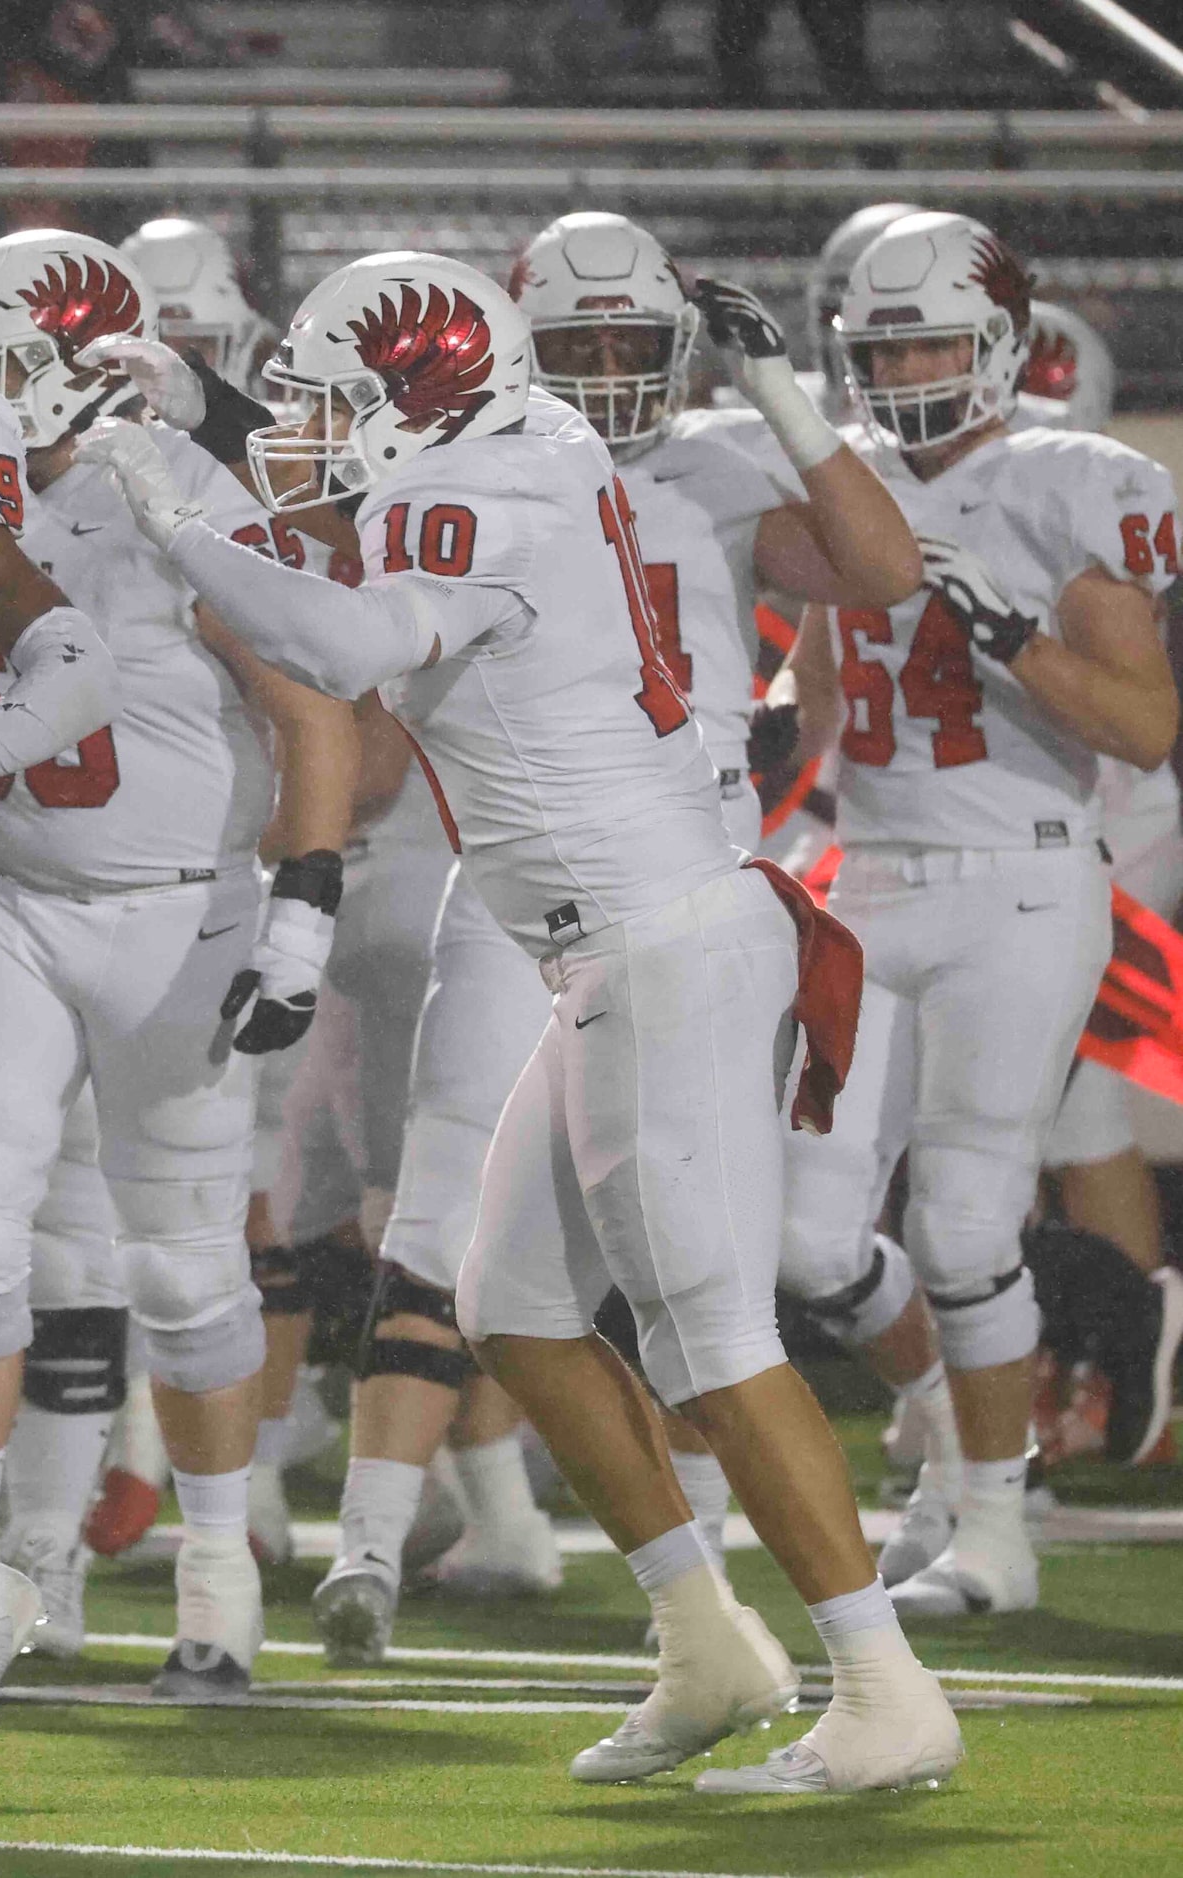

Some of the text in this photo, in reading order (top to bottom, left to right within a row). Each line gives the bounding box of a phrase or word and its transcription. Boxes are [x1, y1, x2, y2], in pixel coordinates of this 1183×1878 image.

[383, 502, 478, 578] 10
[1119, 511, 1180, 575] 64
[836, 583, 989, 769] 64
[557, 913, 568, 925] L
